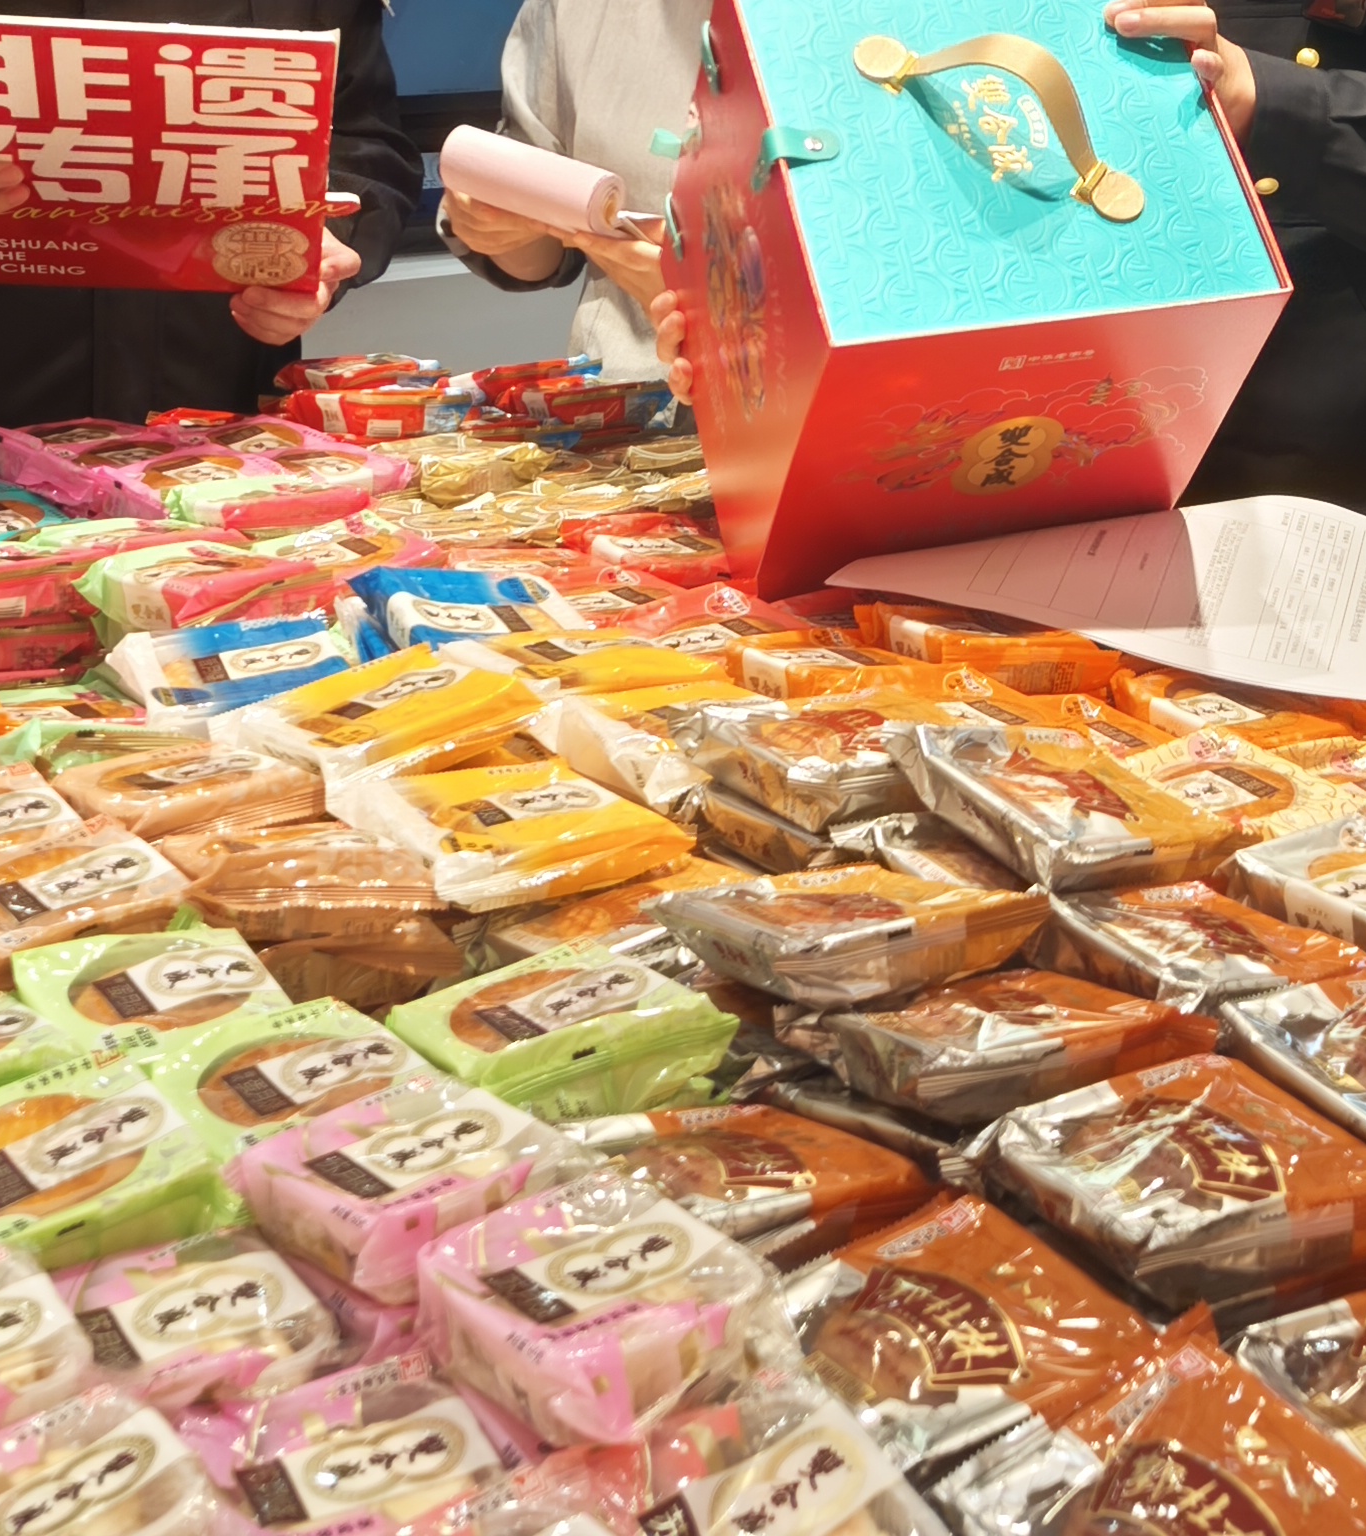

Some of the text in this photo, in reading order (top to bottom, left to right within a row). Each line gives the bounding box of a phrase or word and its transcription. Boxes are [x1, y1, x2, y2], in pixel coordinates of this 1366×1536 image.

[0, 263, 87, 276] CHENG
[980, 424, 1035, 488] 雙合成
[547, 970, 634, 1016] 雙合成
[298, 1039, 393, 1085] 雙合成
[43, 1103, 151, 1166] 雙合成
[388, 1118, 486, 1168] 雙合成
[566, 1233, 676, 1290] 雙合成
[5, 1450, 140, 1534] 雙合成
